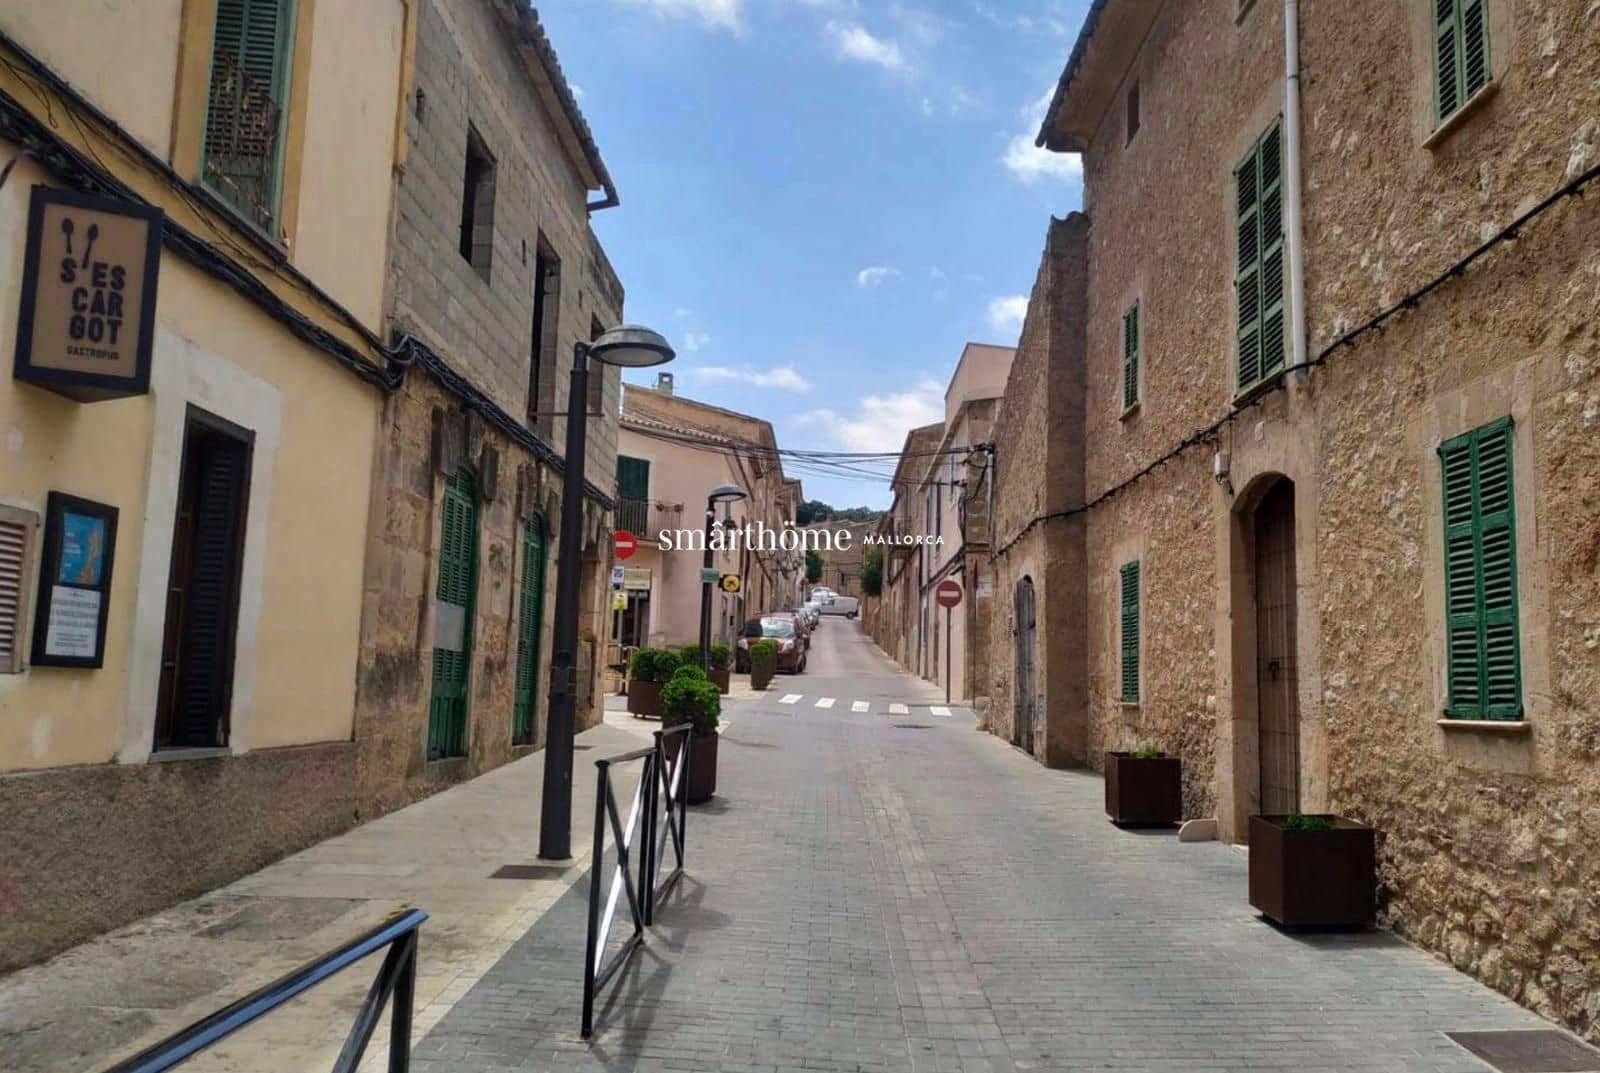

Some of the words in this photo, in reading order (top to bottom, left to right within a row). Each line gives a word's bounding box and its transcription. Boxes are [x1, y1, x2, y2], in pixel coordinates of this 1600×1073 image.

[72, 287, 123, 317] CAR
[70, 315, 122, 345] GOT
[67, 346, 119, 360] GASTROPUB
